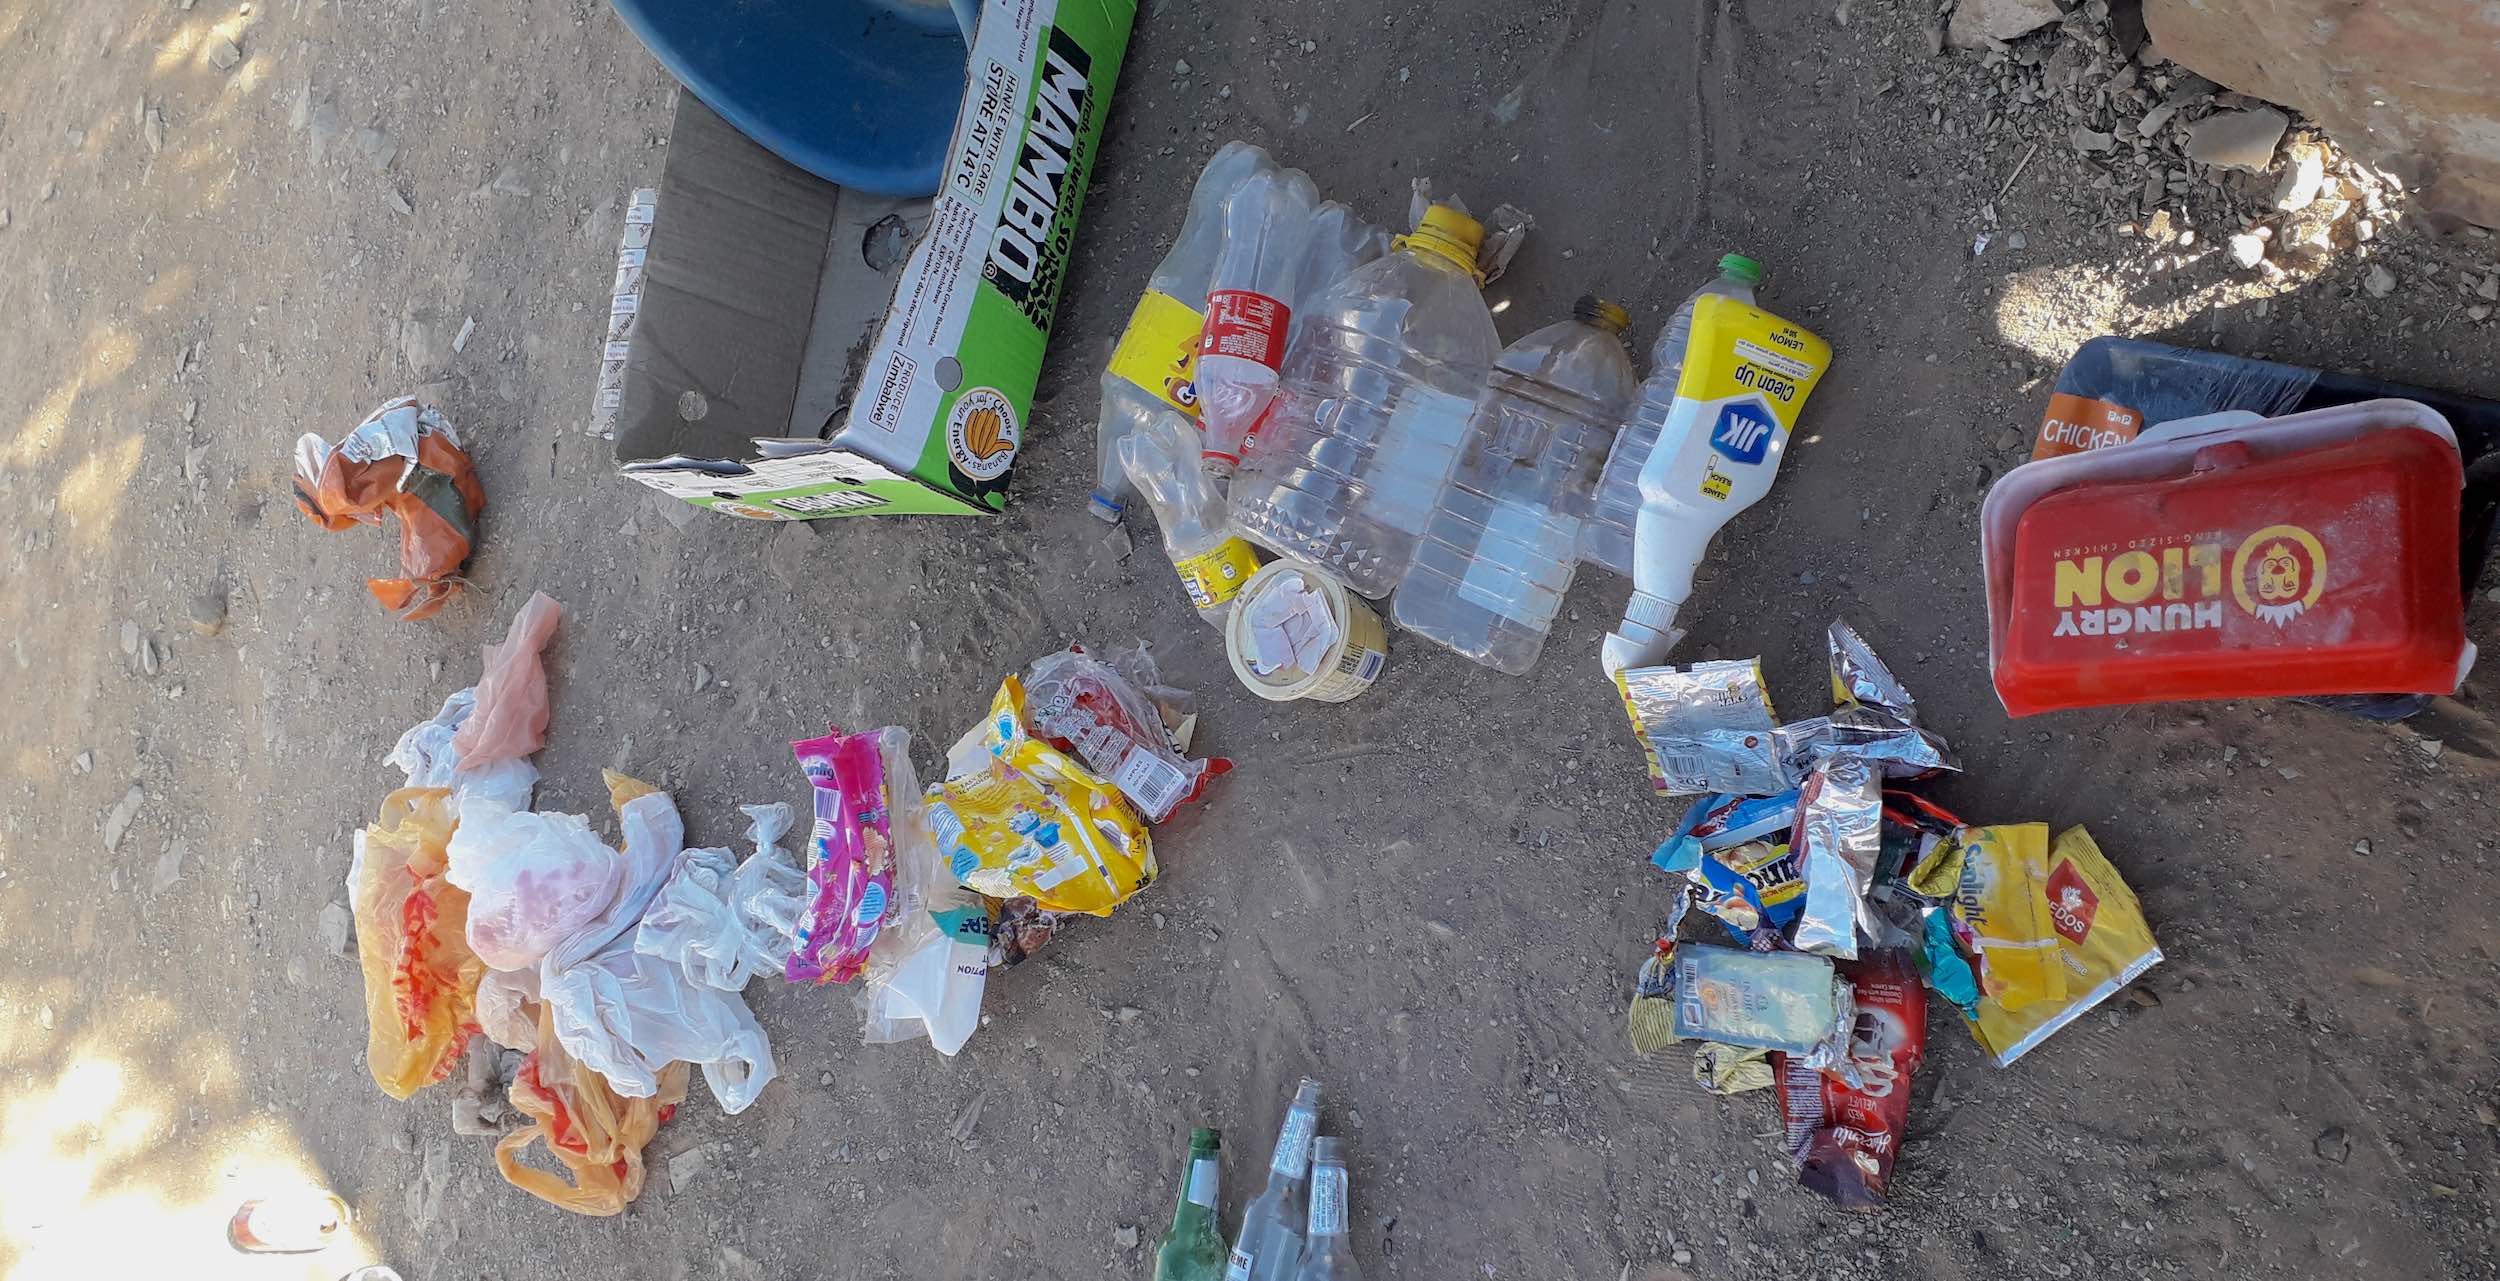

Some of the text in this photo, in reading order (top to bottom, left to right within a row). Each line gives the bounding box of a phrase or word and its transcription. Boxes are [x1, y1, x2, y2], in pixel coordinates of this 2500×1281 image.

[979, 62, 1004, 122] STORE
[973, 122, 988, 148] AT
[986, 127, 1004, 163] WITH
[973, 163, 992, 197] CARE
[989, 47, 1088, 283] MAMBO
[953, 254, 963, 272] Only
[947, 272, 957, 292] Fresh
[940, 292, 950, 315] Green
[898, 317, 911, 346] ripened
[1768, 332, 1804, 351] LEMON
[873, 355, 905, 421] Zimbabwe
[886, 361, 914, 429] PRODUCE OF
[1734, 365, 1795, 402] Clean Up
[952, 392, 1012, 471] Choose Bananas for your Energy
[1715, 412, 1769, 453] JIK
[2107, 410, 2132, 426] PnP
[2043, 419, 2127, 449] CHICKEN
[2053, 542, 2118, 560] CHICKEN
[2054, 543, 2222, 609] LION
[2053, 600, 2222, 637] HUNGRY
[1126, 759, 1142, 781] APPLES
[2050, 901, 2087, 934] EDOS
[957, 963, 987, 977] PTION
[1847, 1109, 1866, 1122] RED
[1849, 1095, 1878, 1112] VELVET
